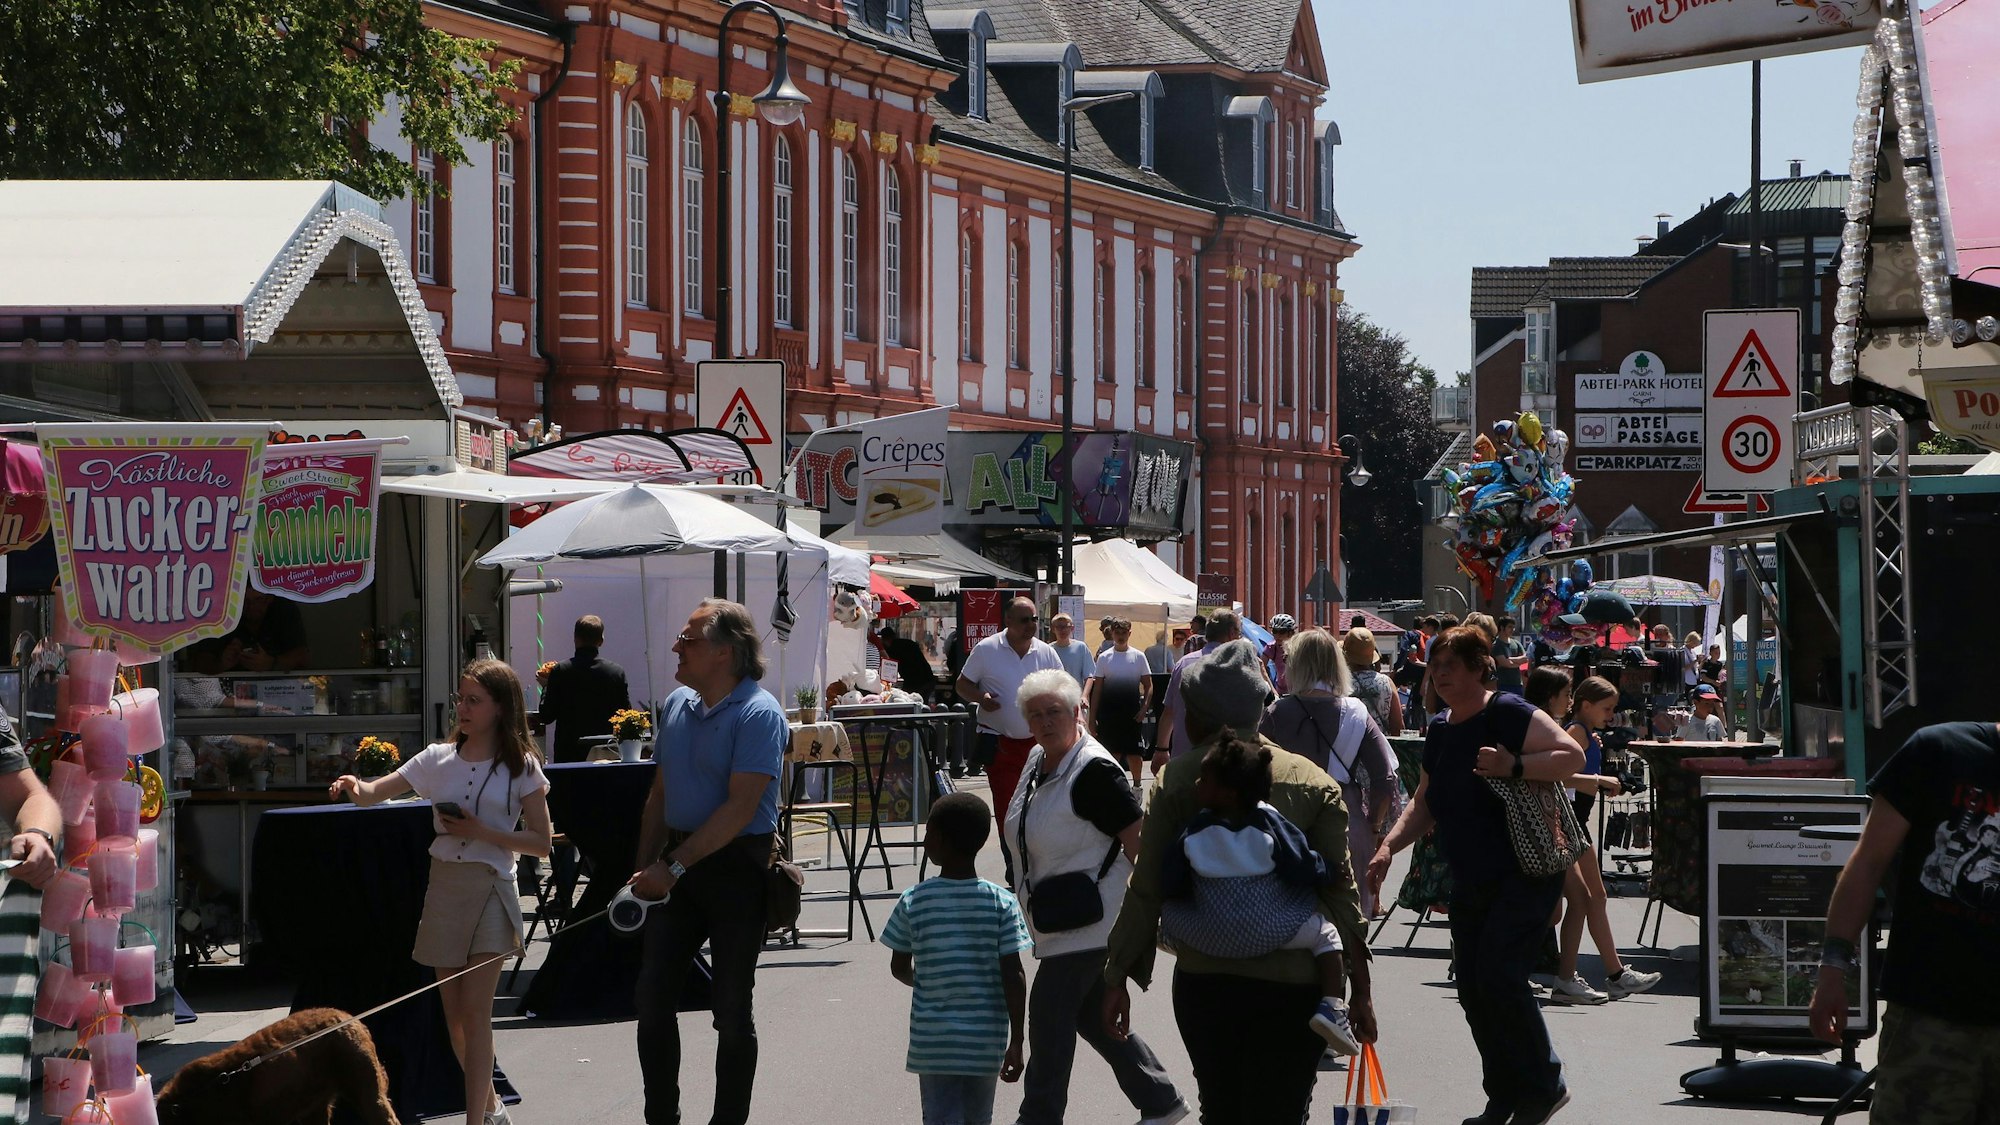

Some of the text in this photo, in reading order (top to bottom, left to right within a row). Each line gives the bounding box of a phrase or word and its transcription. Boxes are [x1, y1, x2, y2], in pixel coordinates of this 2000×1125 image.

[1627, 5, 1654, 33] im
[1580, 378, 1702, 390] ABTEI-PARK HOTEL
[1617, 416, 1668, 429] ABTEI
[1617, 431, 1699, 443] PASSAGE
[1734, 431, 1768, 458] 30
[863, 436, 945, 473] Crêpes
[1595, 457, 1682, 469] PARKPLATZ
[79, 451, 232, 492] Köstliche
[268, 470, 345, 489] Sweet Street
[965, 444, 1057, 511] ALL
[64, 487, 250, 553] Zucker-
[85, 554, 213, 623] watte
[1198, 592, 1228, 601] CLASSIC
